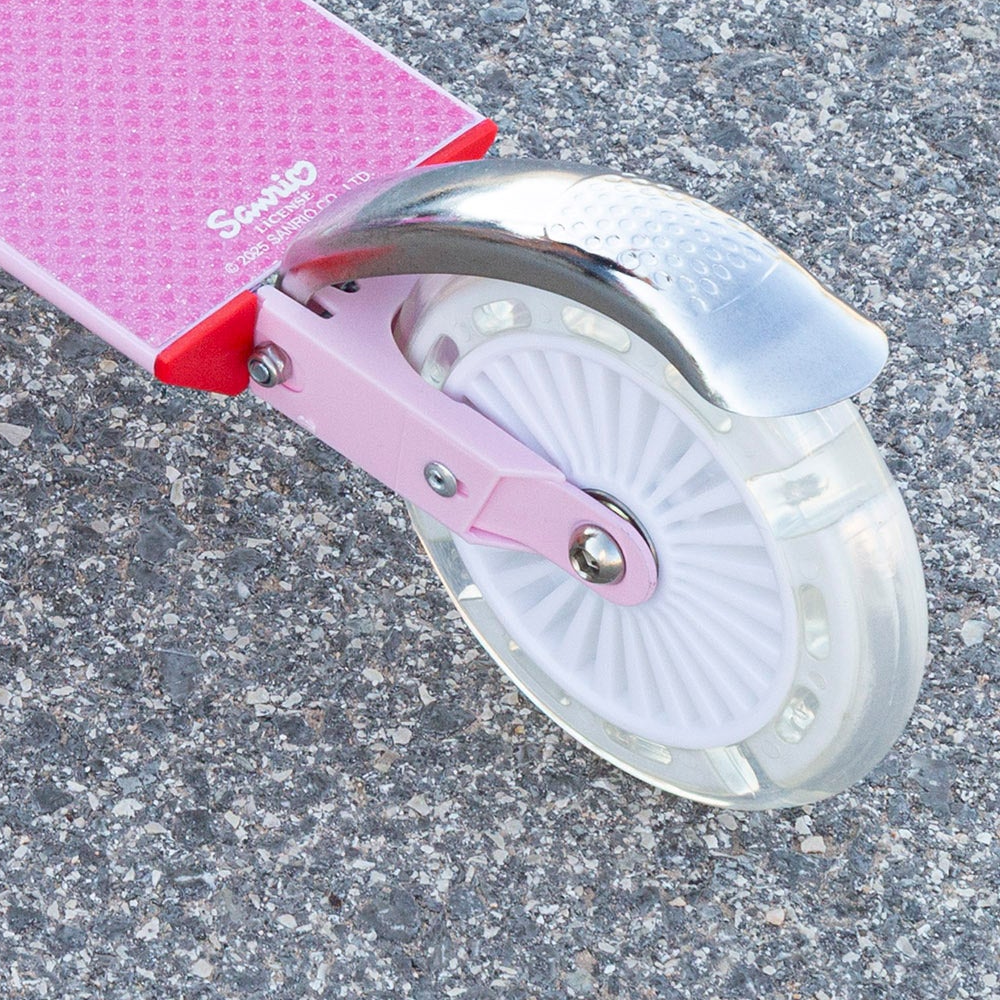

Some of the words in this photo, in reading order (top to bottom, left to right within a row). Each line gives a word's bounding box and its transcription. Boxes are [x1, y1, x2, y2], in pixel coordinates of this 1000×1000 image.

[206, 160, 318, 239] Sanrio
[255, 190, 315, 234] LICENSE
[236, 240, 270, 266] 2025
[266, 208, 318, 245] SANRIO
